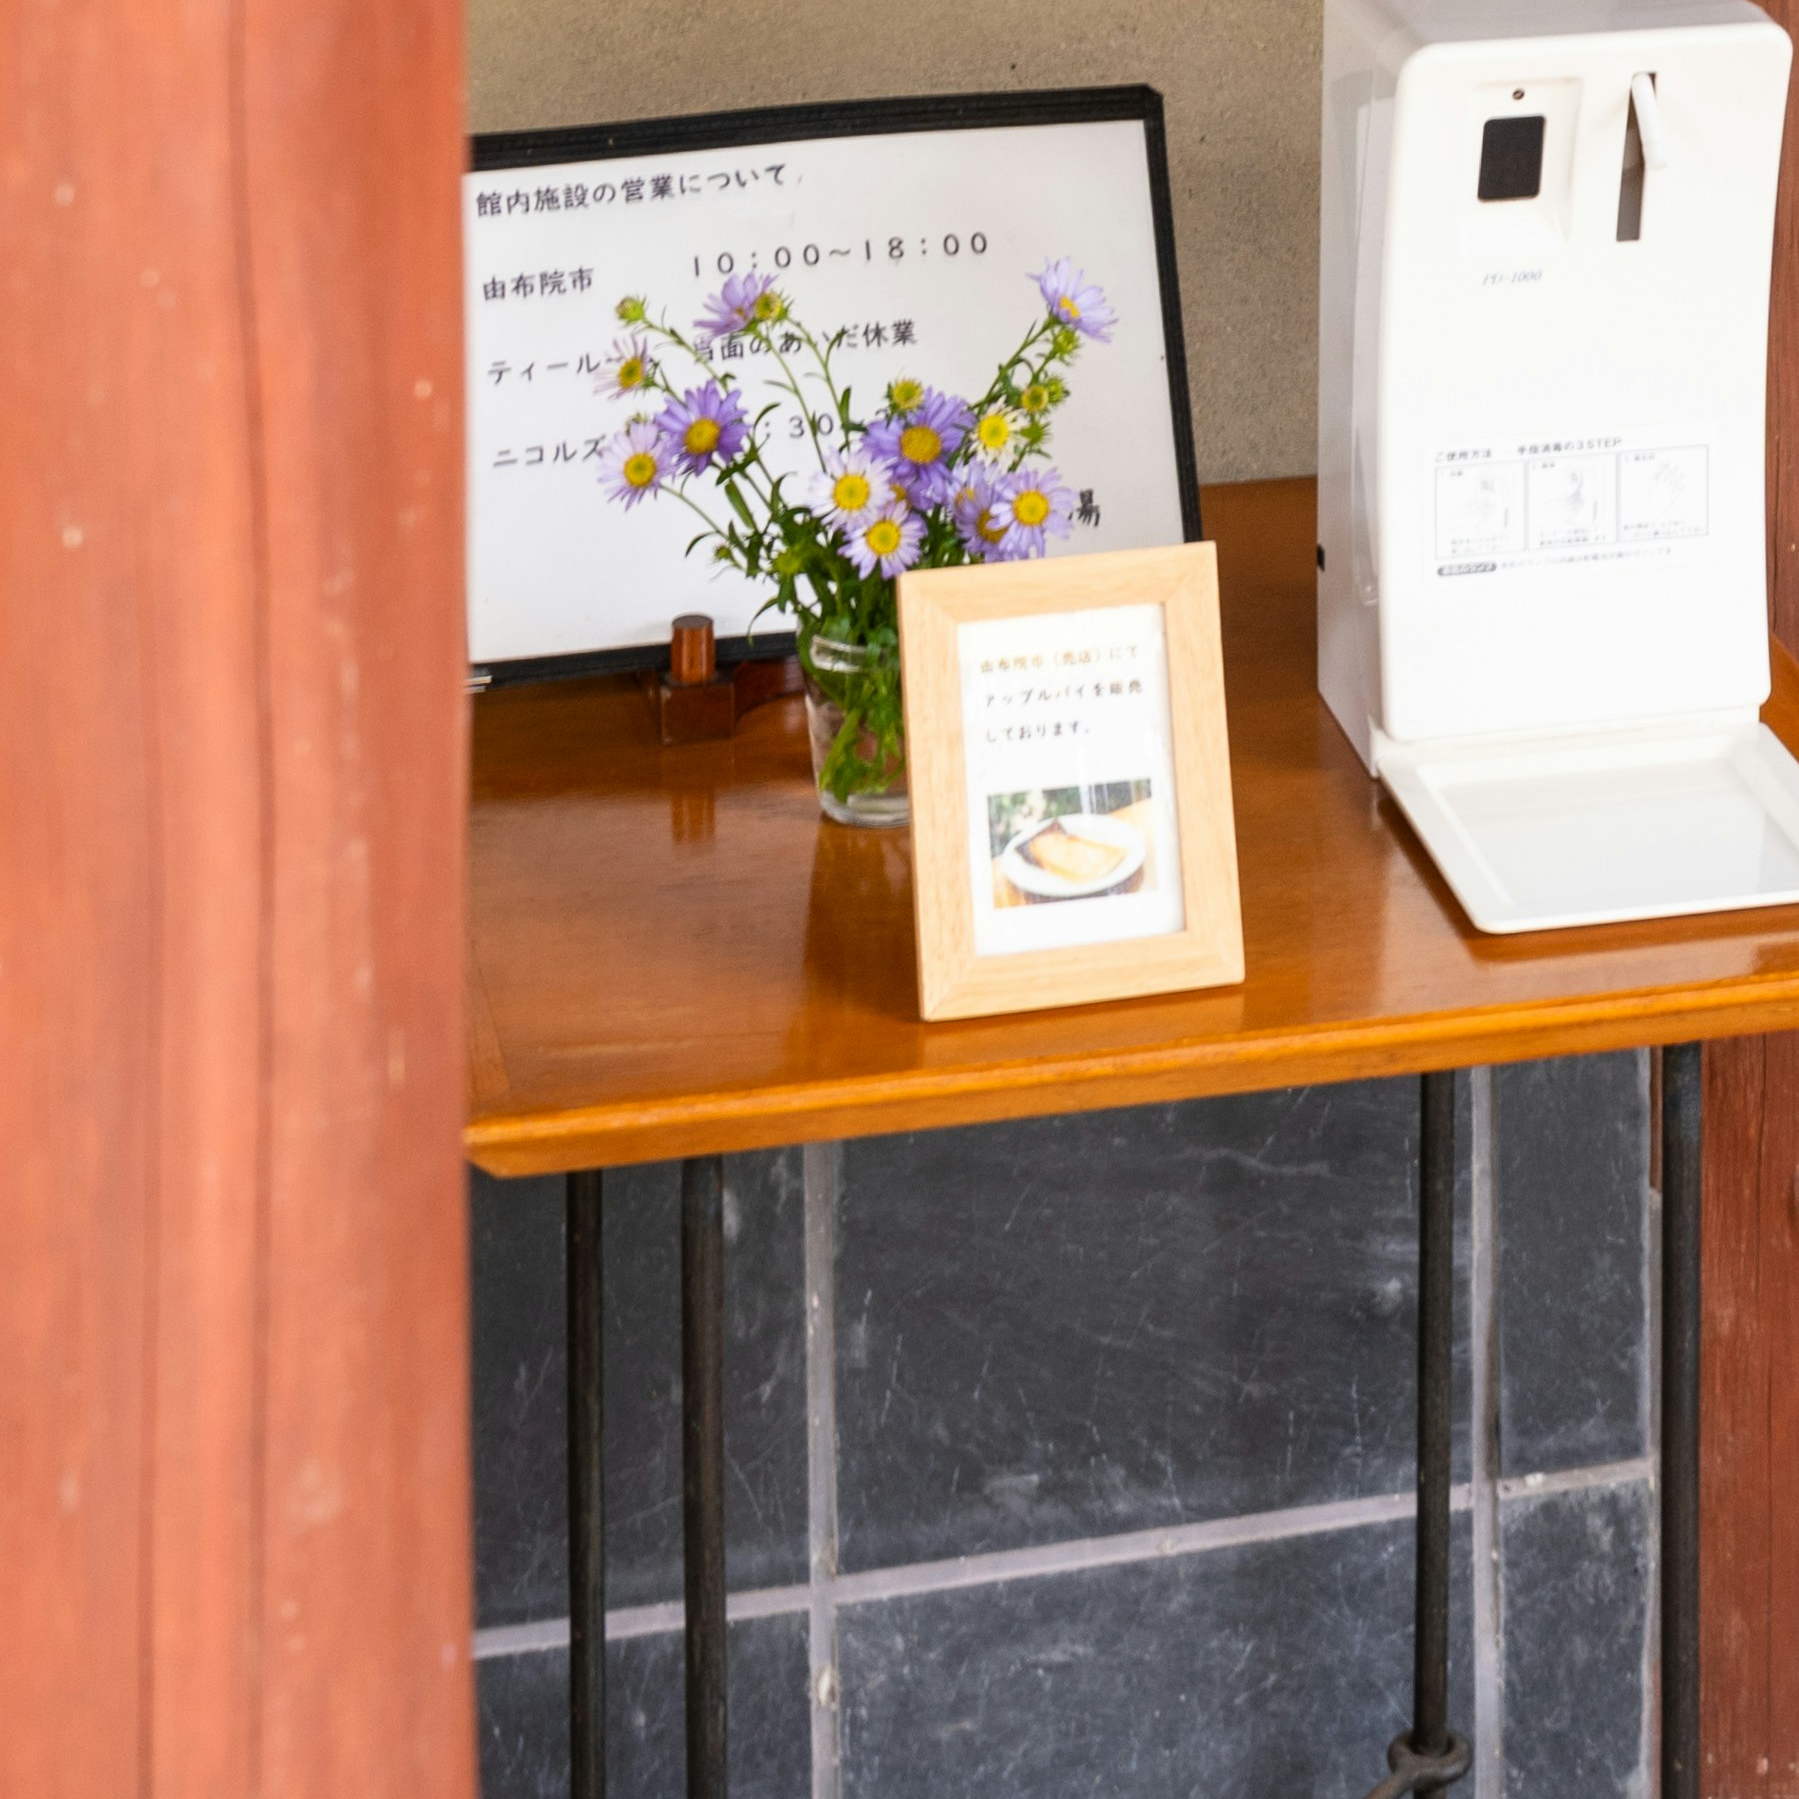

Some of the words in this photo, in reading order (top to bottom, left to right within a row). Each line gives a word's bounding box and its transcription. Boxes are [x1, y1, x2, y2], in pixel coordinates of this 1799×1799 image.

[475, 163, 788, 218] 館内施設の営業について
[482, 266, 595, 302] 由布院市
[986, 720, 1091, 744] しております。
